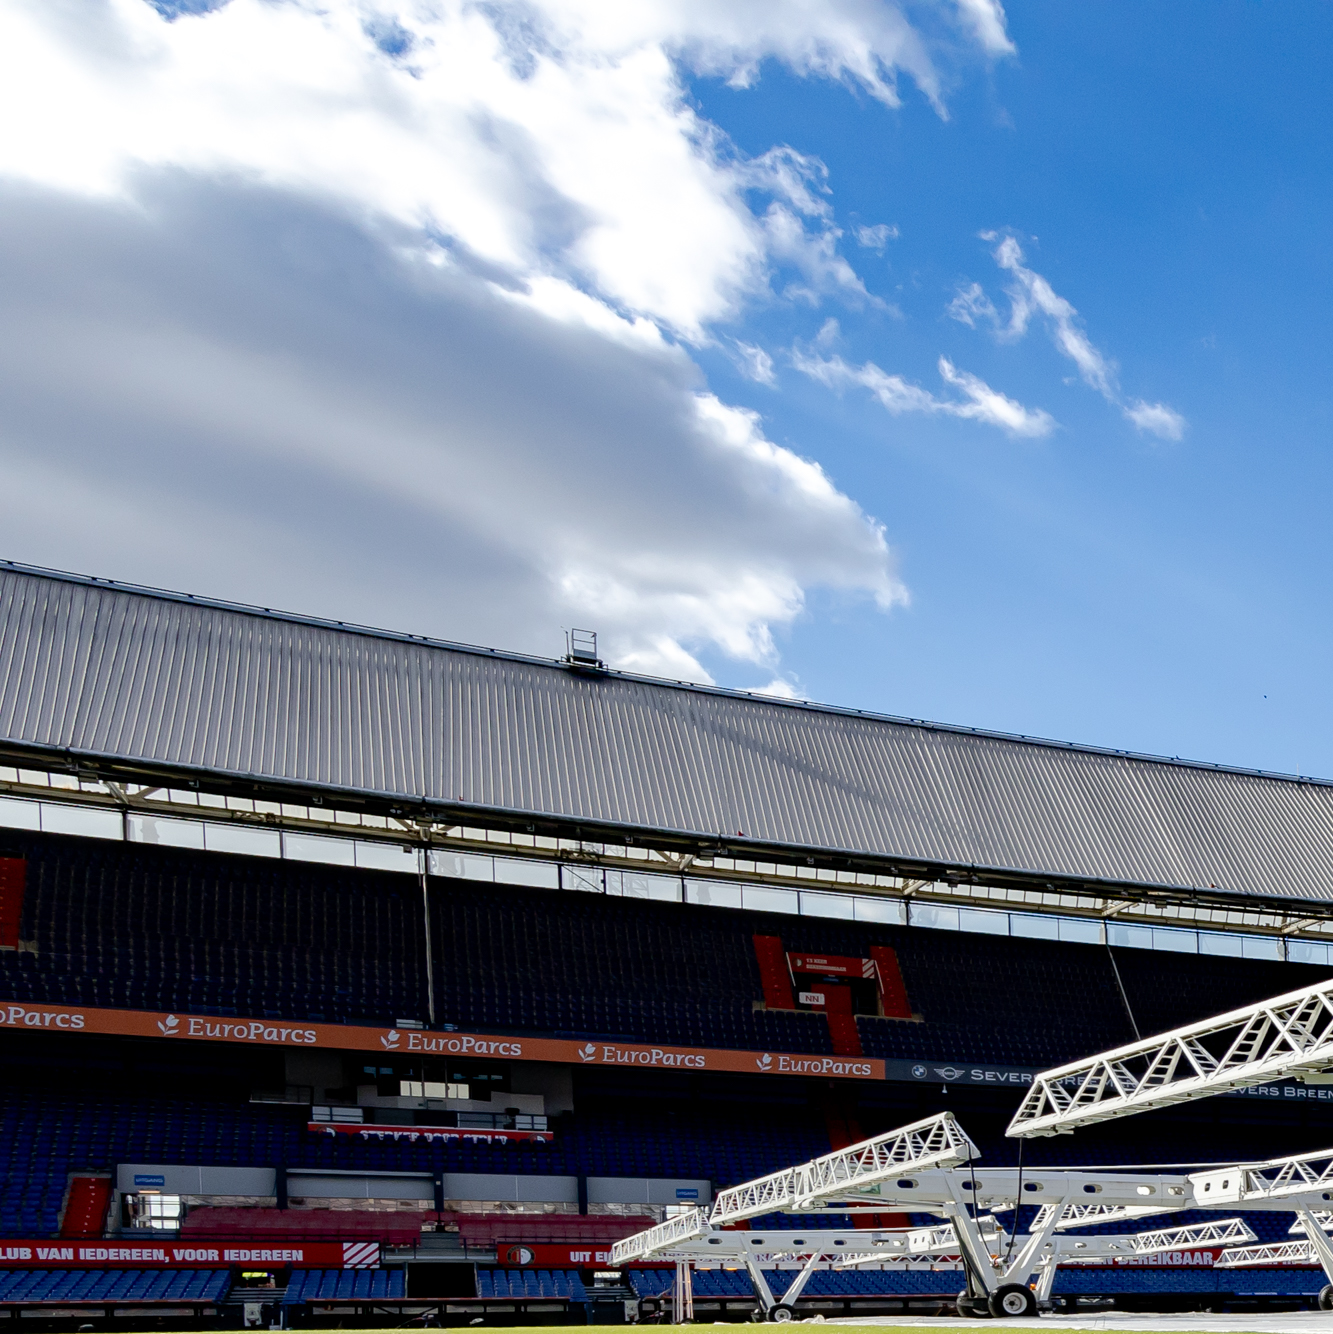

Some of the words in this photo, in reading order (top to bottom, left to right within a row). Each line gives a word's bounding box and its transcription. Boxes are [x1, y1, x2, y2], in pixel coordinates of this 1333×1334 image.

[805, 995, 820, 1003] NN
[187, 1018, 317, 1044] EuroParcs
[407, 1033, 522, 1056] EuroParcs
[602, 1046, 705, 1068] EuroParcs
[778, 1056, 872, 1076] EuroParcs
[35, 1247, 74, 1260] VAN
[79, 1248, 170, 1263] IEDEREEN,
[173, 1248, 220, 1262] VOOR
[223, 1249, 304, 1262] IEDEREEN
[570, 1251, 592, 1263] UIT
